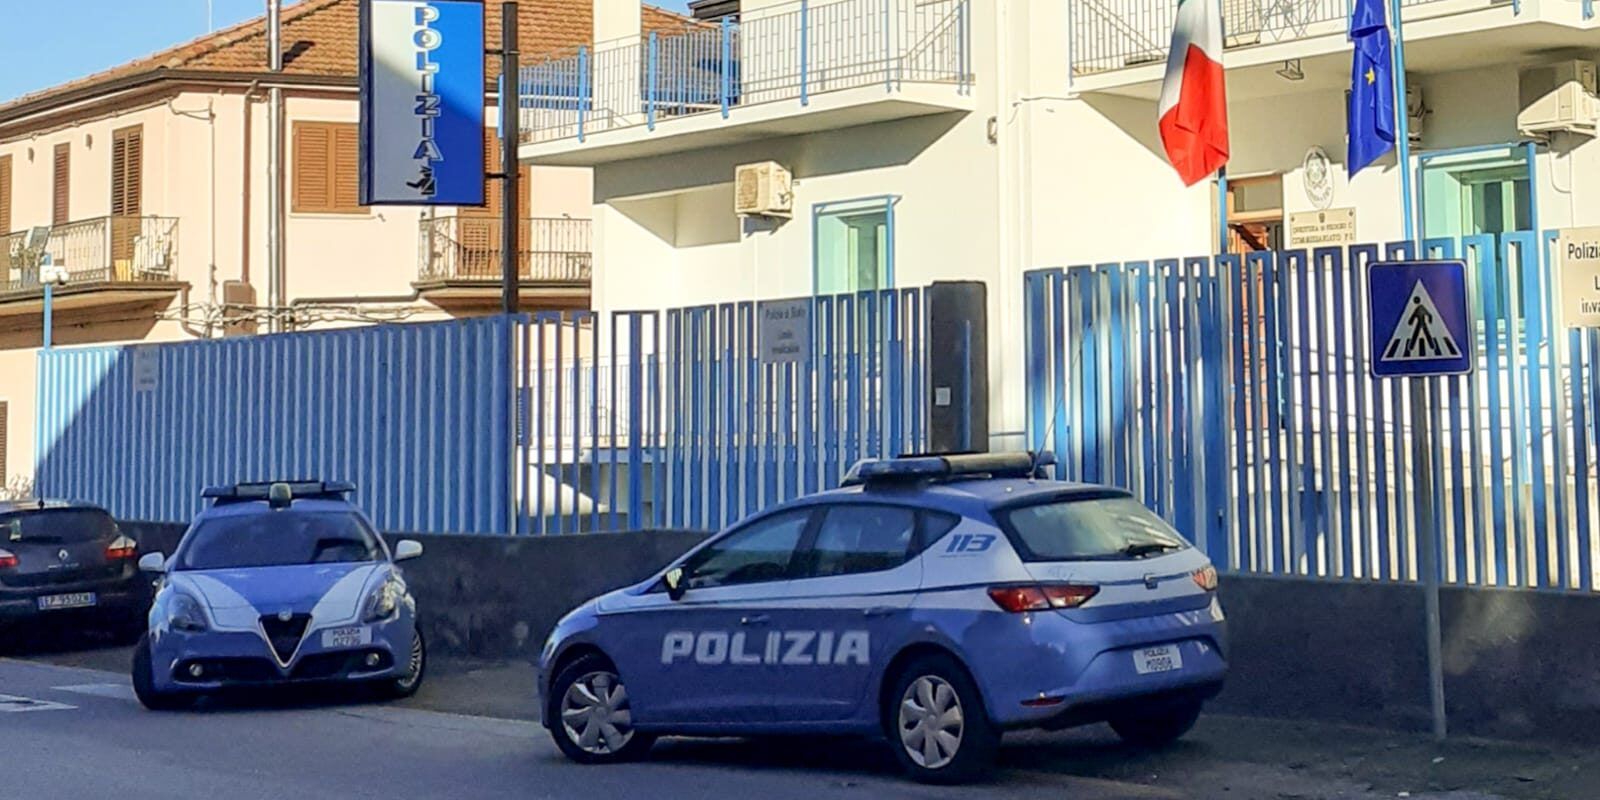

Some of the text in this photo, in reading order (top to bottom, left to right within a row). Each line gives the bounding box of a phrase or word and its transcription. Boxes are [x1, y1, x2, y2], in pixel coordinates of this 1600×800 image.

[413, 6, 443, 161] POLIZIA
[1568, 241, 1600, 259] Polizi
[946, 534, 996, 553] 113
[661, 630, 870, 665] POLIZIA
